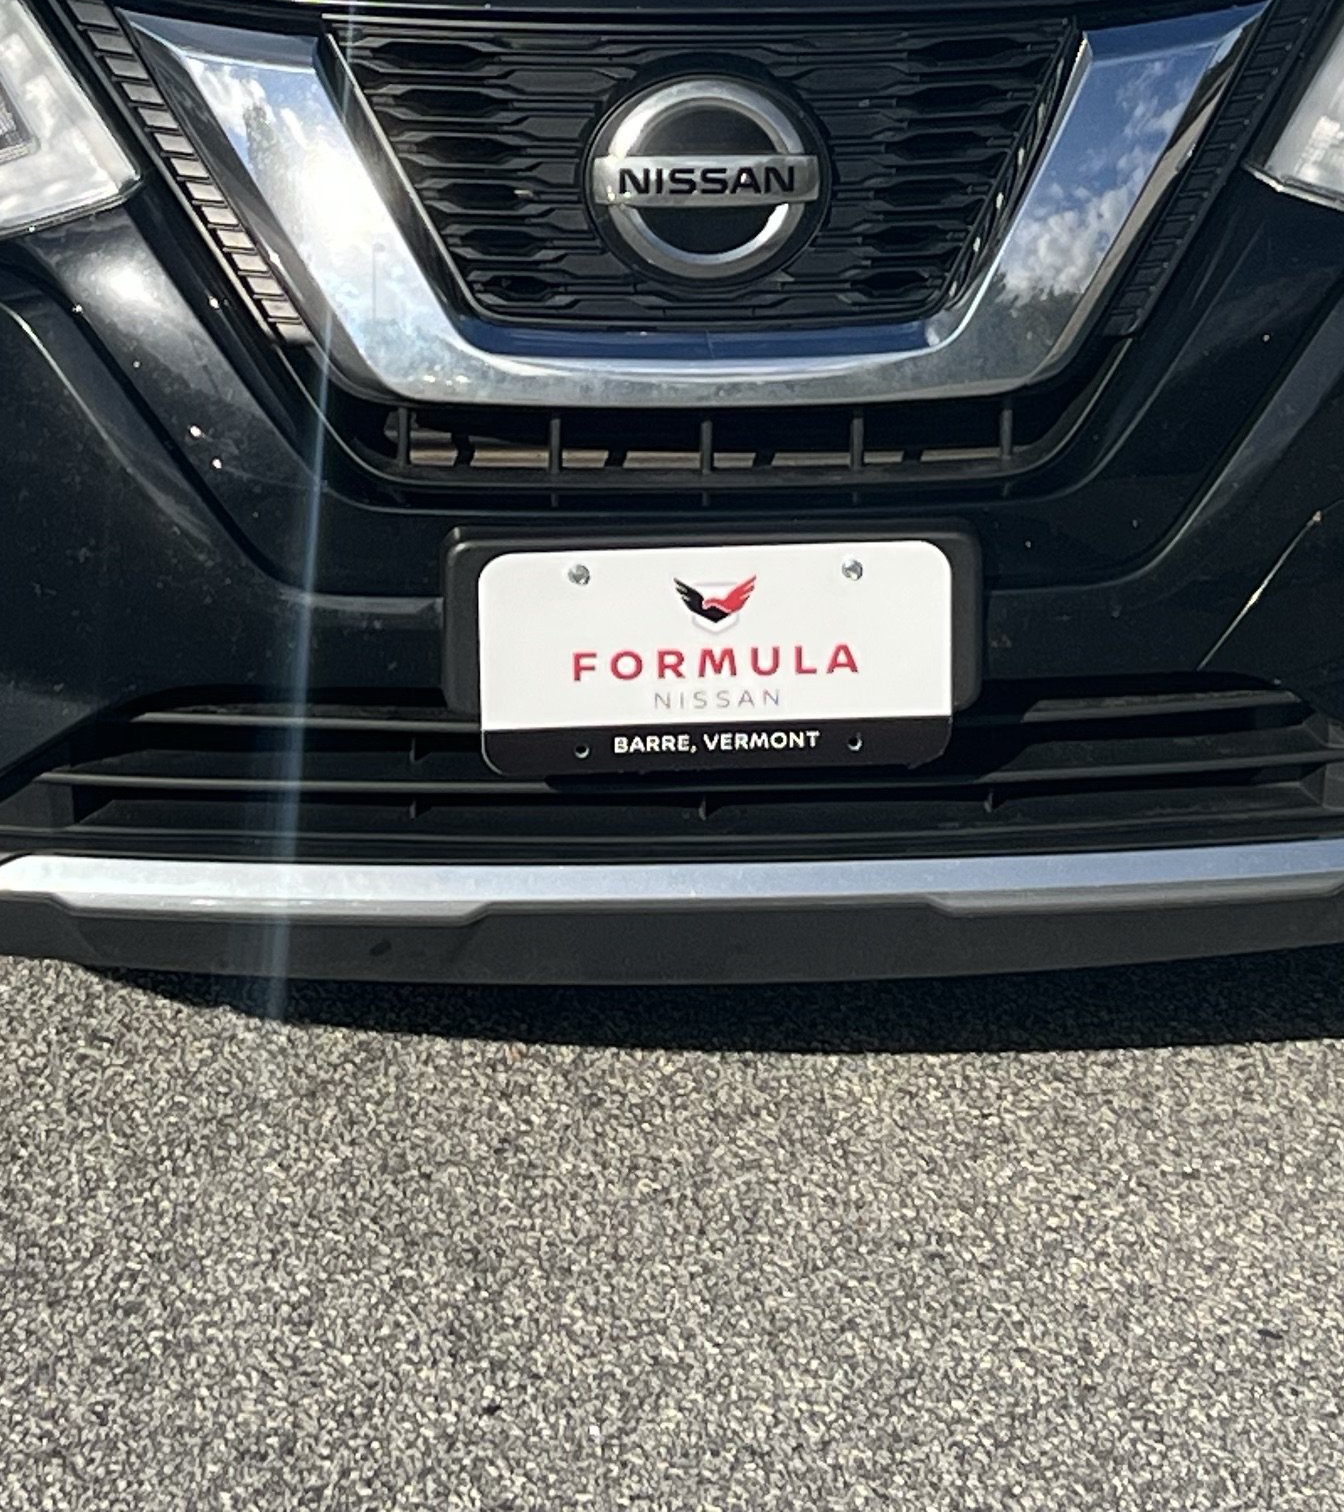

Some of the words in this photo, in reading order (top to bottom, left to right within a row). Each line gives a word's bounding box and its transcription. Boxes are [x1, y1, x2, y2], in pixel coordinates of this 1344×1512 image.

[618, 165, 795, 195] NISSAN
[572, 643, 859, 682] FORMULA
[653, 688, 782, 710] NISSAN
[613, 734, 697, 754] BARRE,
[703, 730, 821, 751] VERMONT
